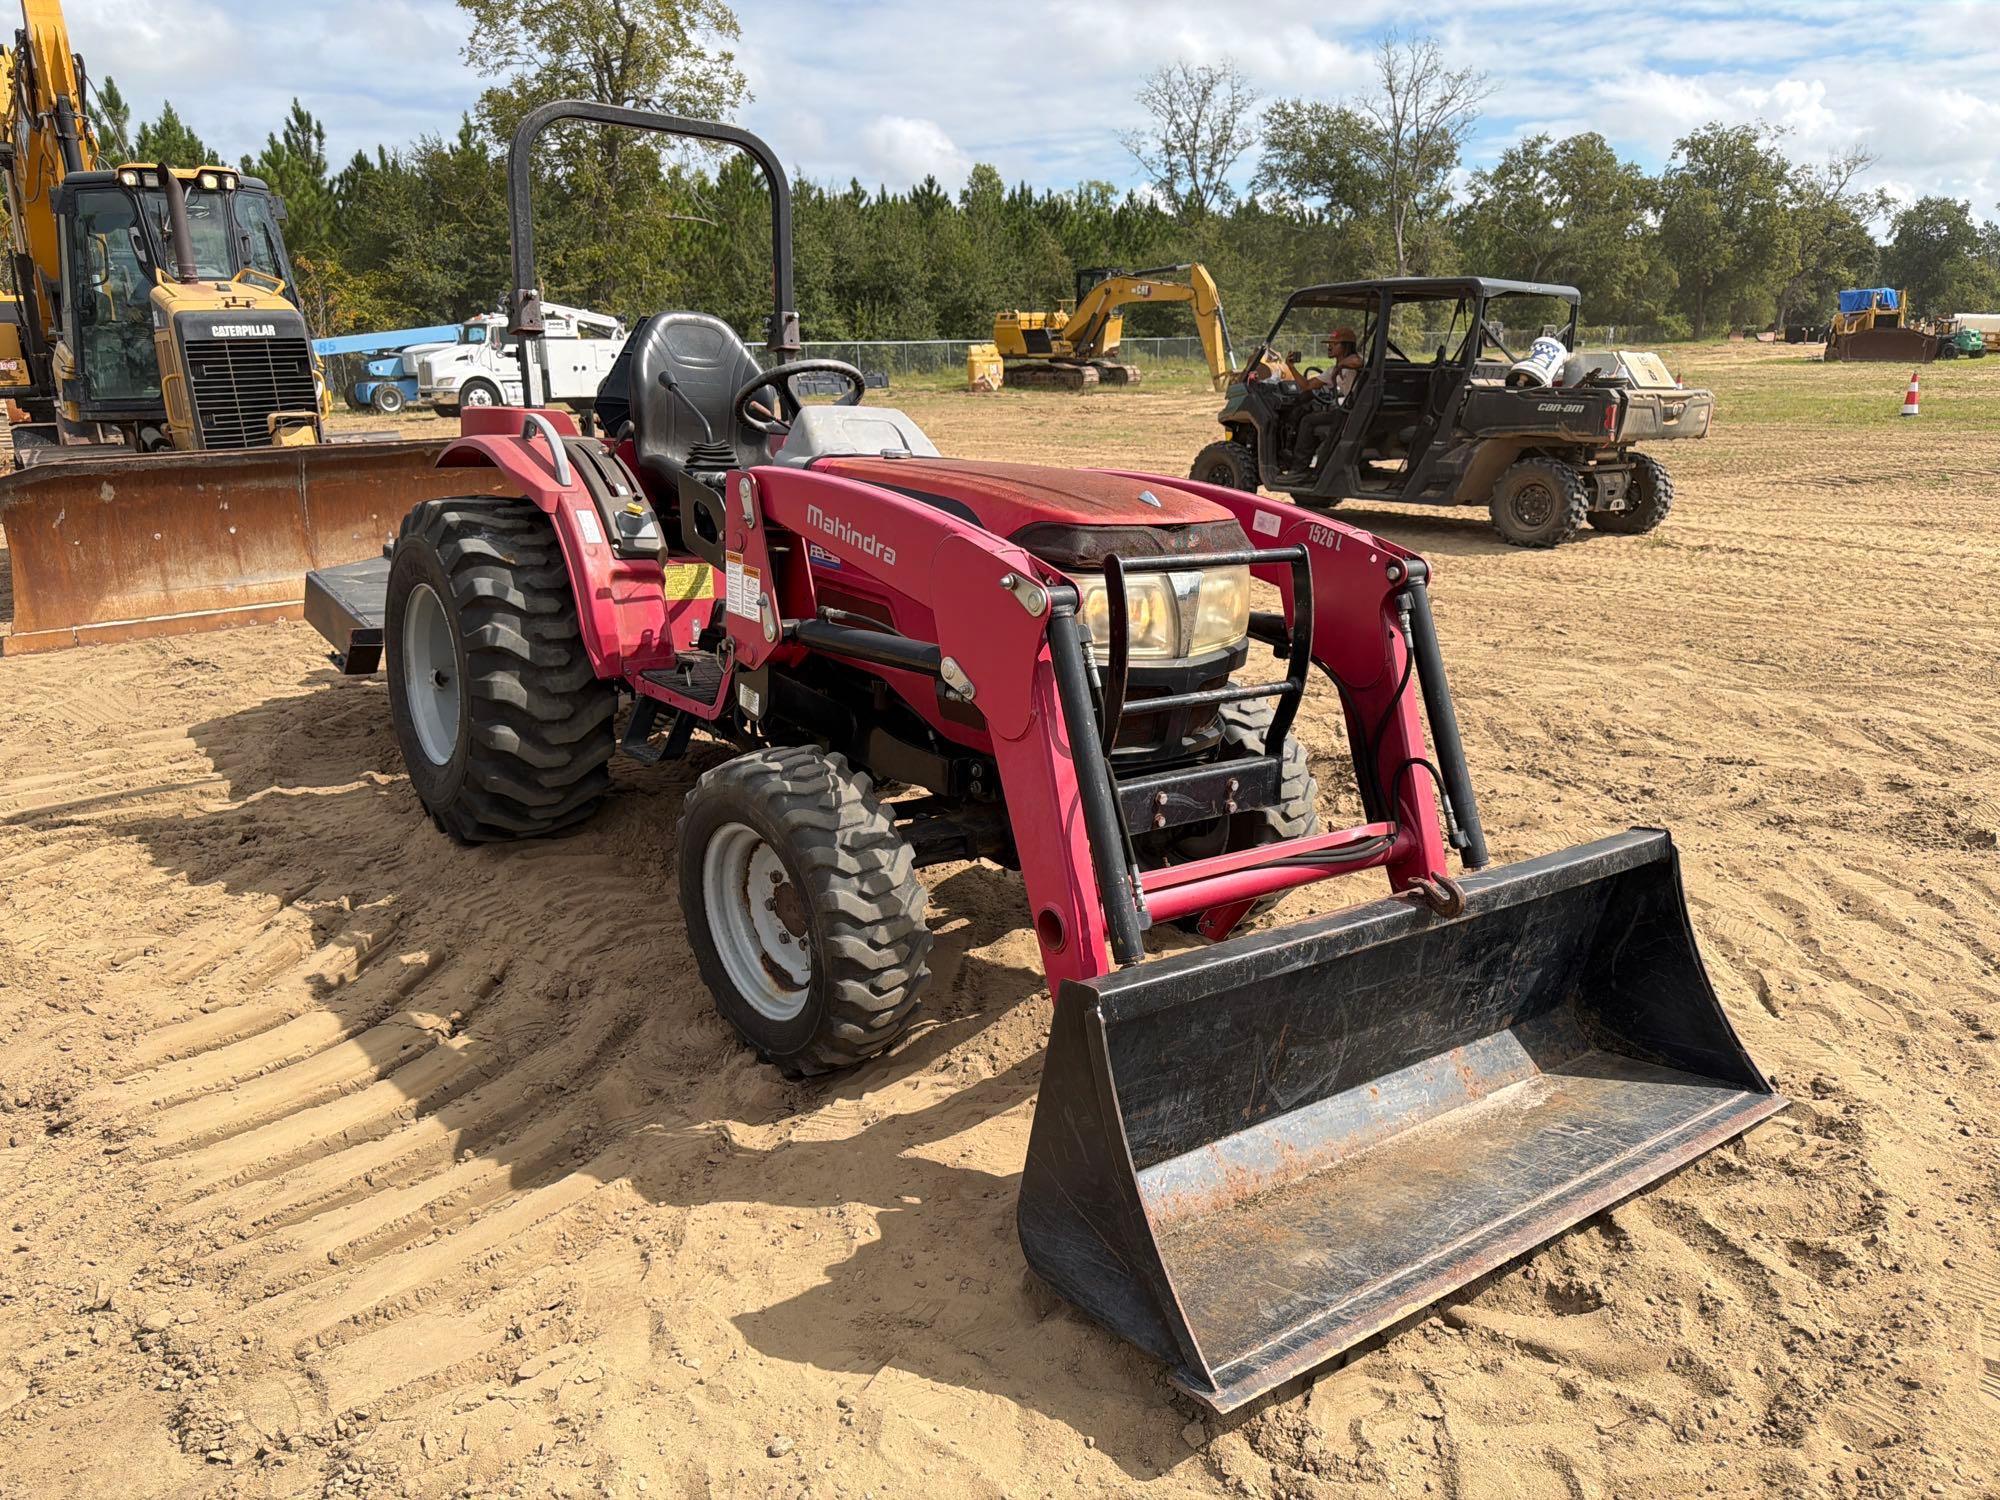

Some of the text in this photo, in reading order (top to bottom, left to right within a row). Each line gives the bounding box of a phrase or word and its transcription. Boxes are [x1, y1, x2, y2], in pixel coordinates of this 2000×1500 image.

[211, 325, 276, 337] CATERPILLAR
[1537, 403, 1585, 413] can-am
[807, 504, 896, 566] Mahindra
[1308, 524, 1335, 548] 1526
